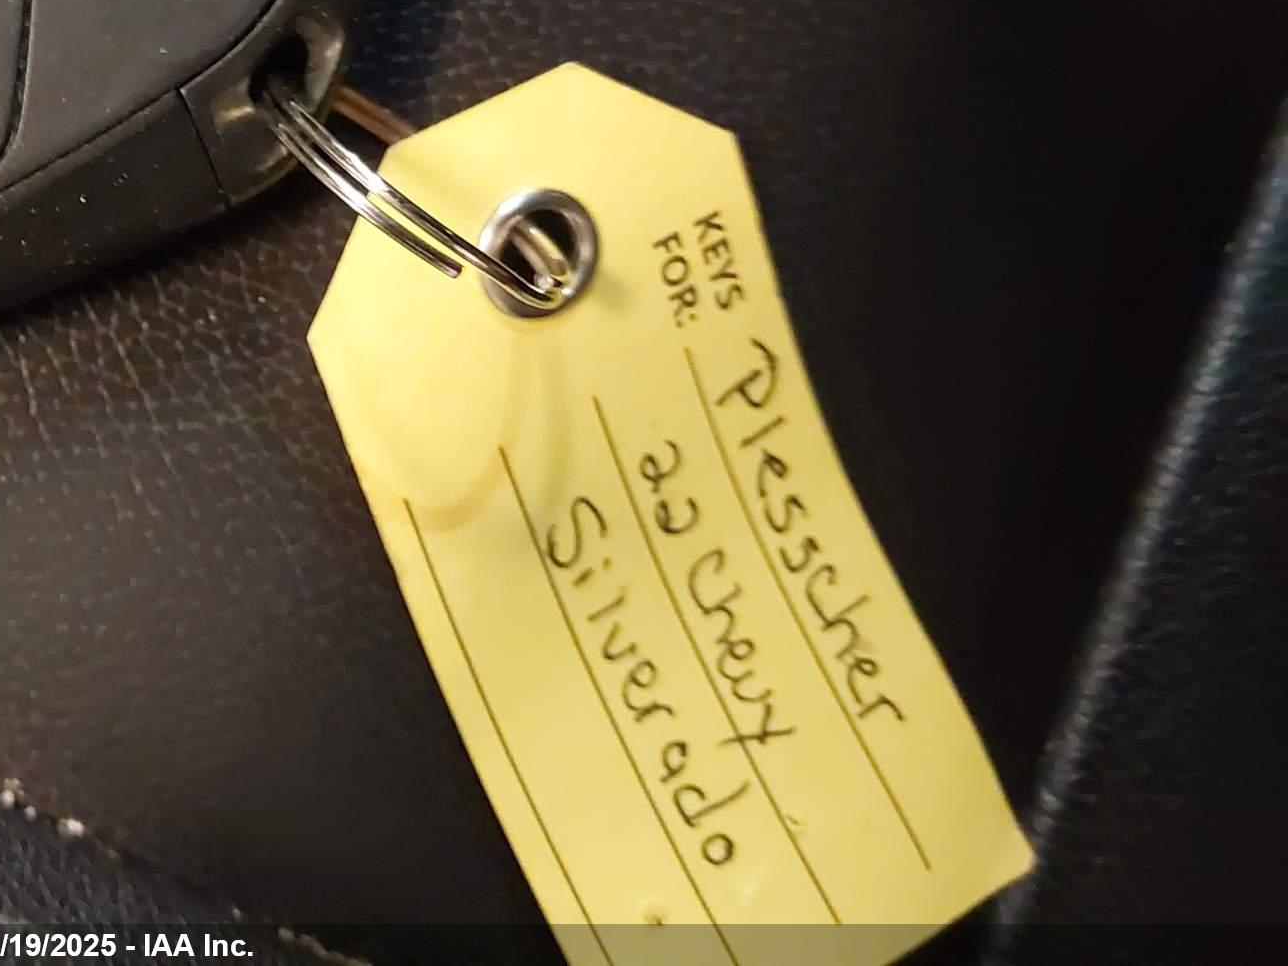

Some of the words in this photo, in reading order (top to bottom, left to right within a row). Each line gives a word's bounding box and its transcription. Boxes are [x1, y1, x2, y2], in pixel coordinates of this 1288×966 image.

[653, 231, 698, 328] FOR:
[694, 211, 745, 311] KEYS
[639, 440, 697, 535] 22
